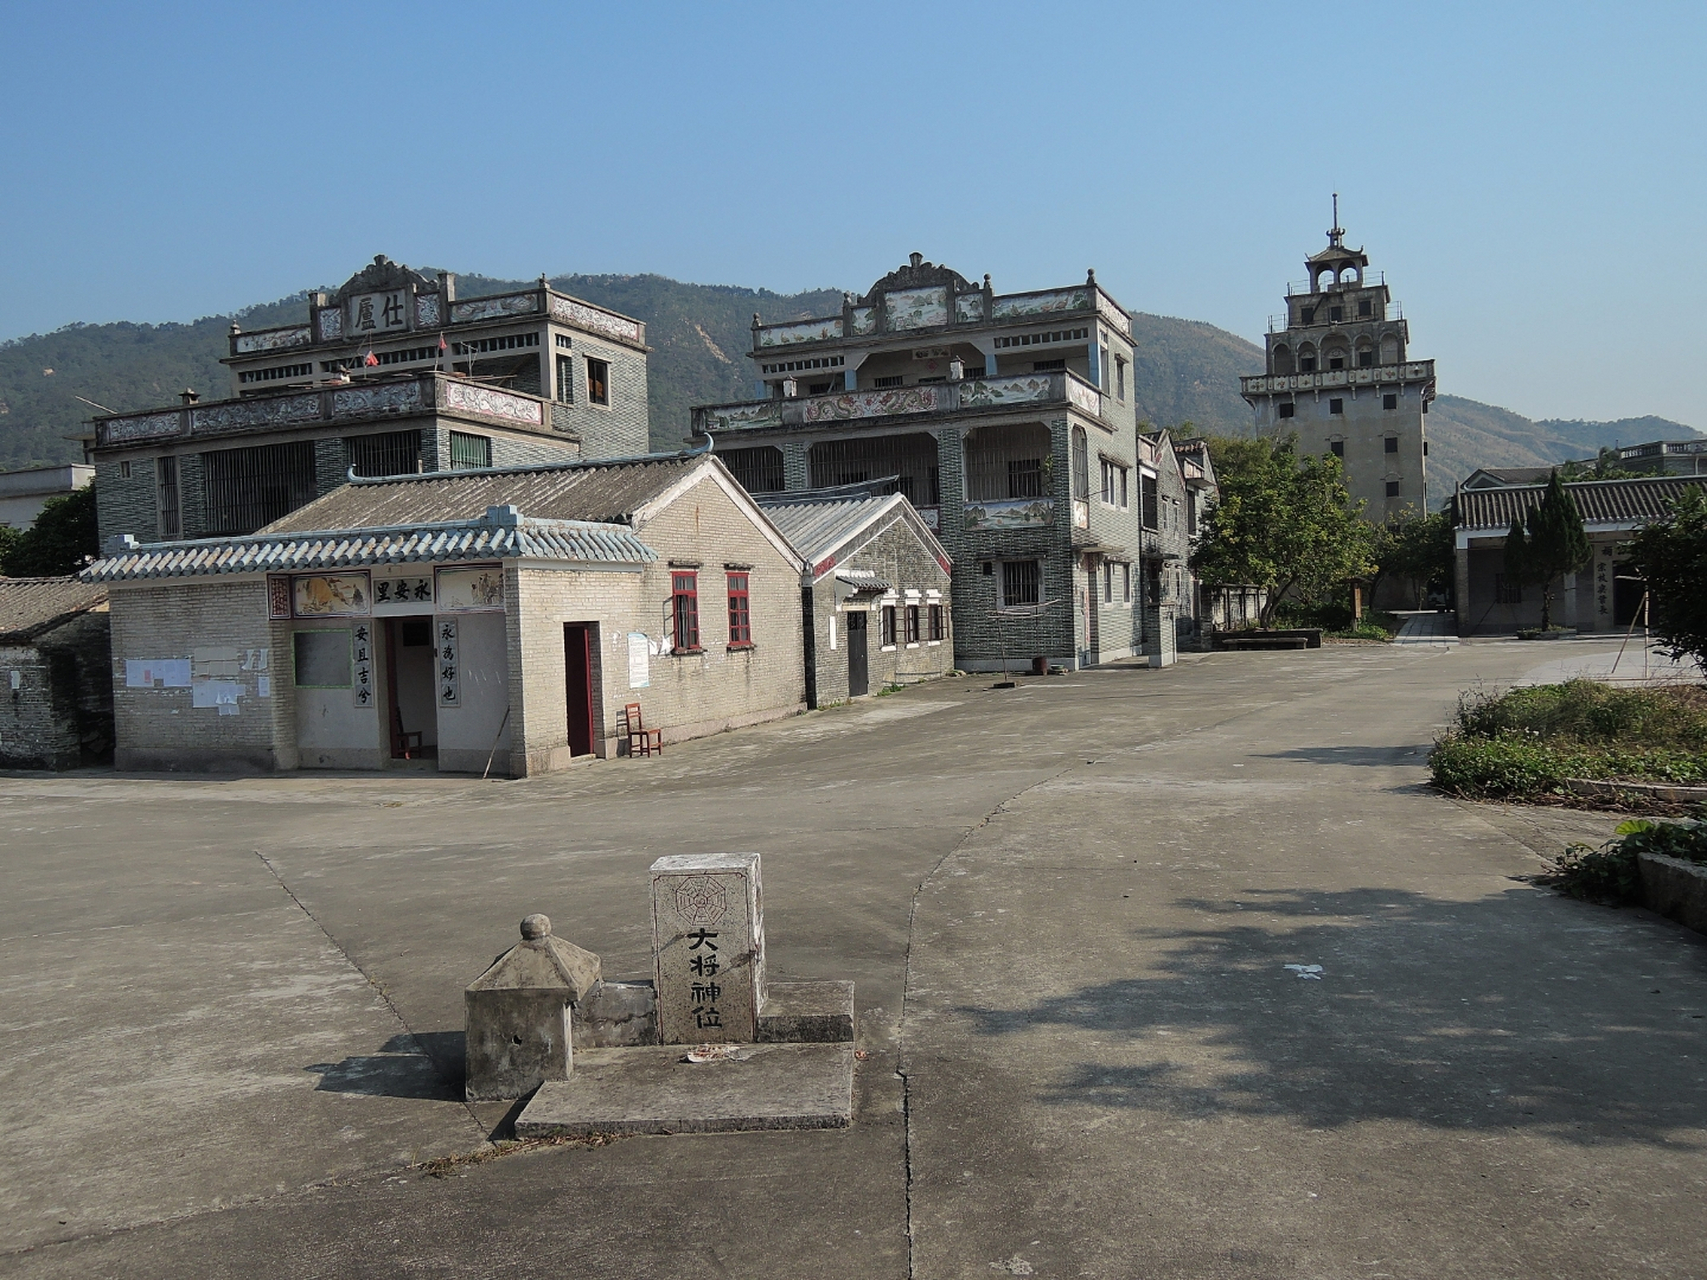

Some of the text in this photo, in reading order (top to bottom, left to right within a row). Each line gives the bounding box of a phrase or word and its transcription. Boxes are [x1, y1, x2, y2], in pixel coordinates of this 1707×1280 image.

[377, 579, 431, 602] 永安里
[355, 626, 371, 704] 安且吉兮
